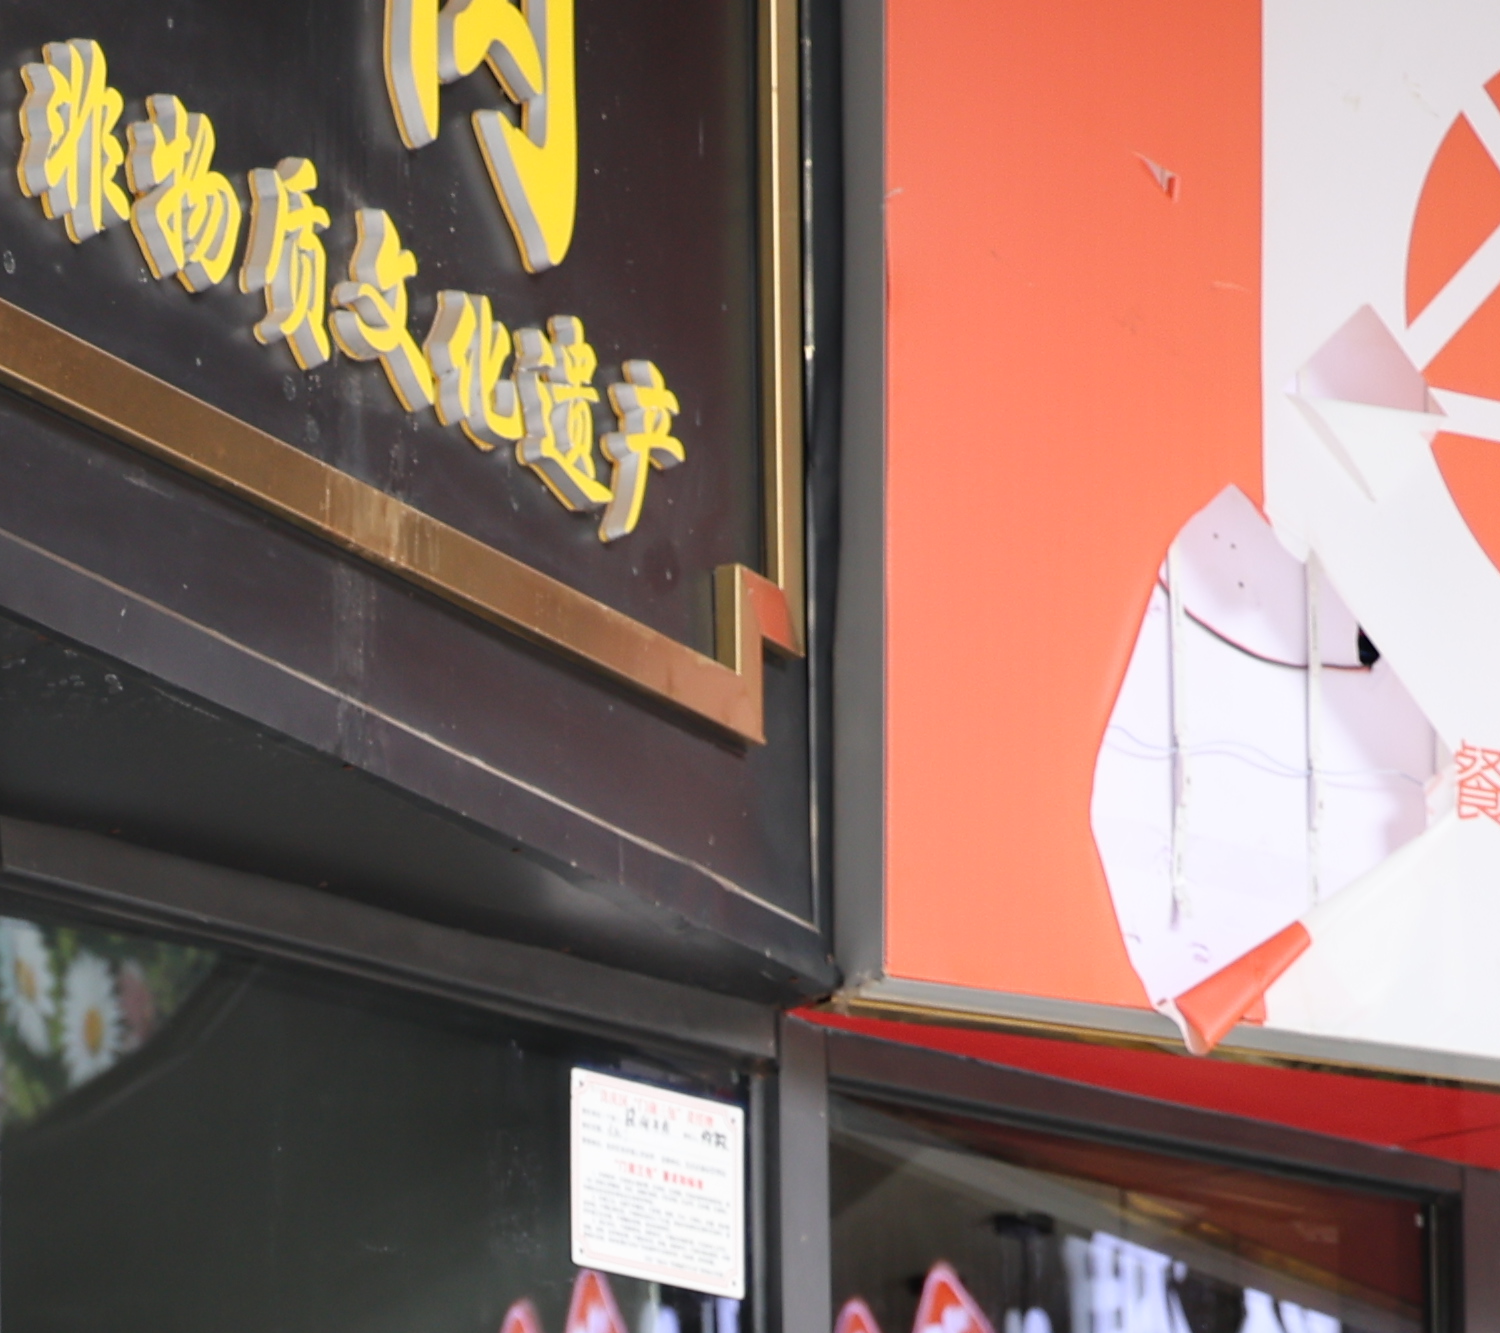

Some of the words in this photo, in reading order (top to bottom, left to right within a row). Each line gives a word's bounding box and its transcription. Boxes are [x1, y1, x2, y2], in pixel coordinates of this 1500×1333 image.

[18, 38, 686, 541] 非物质文化遗产
